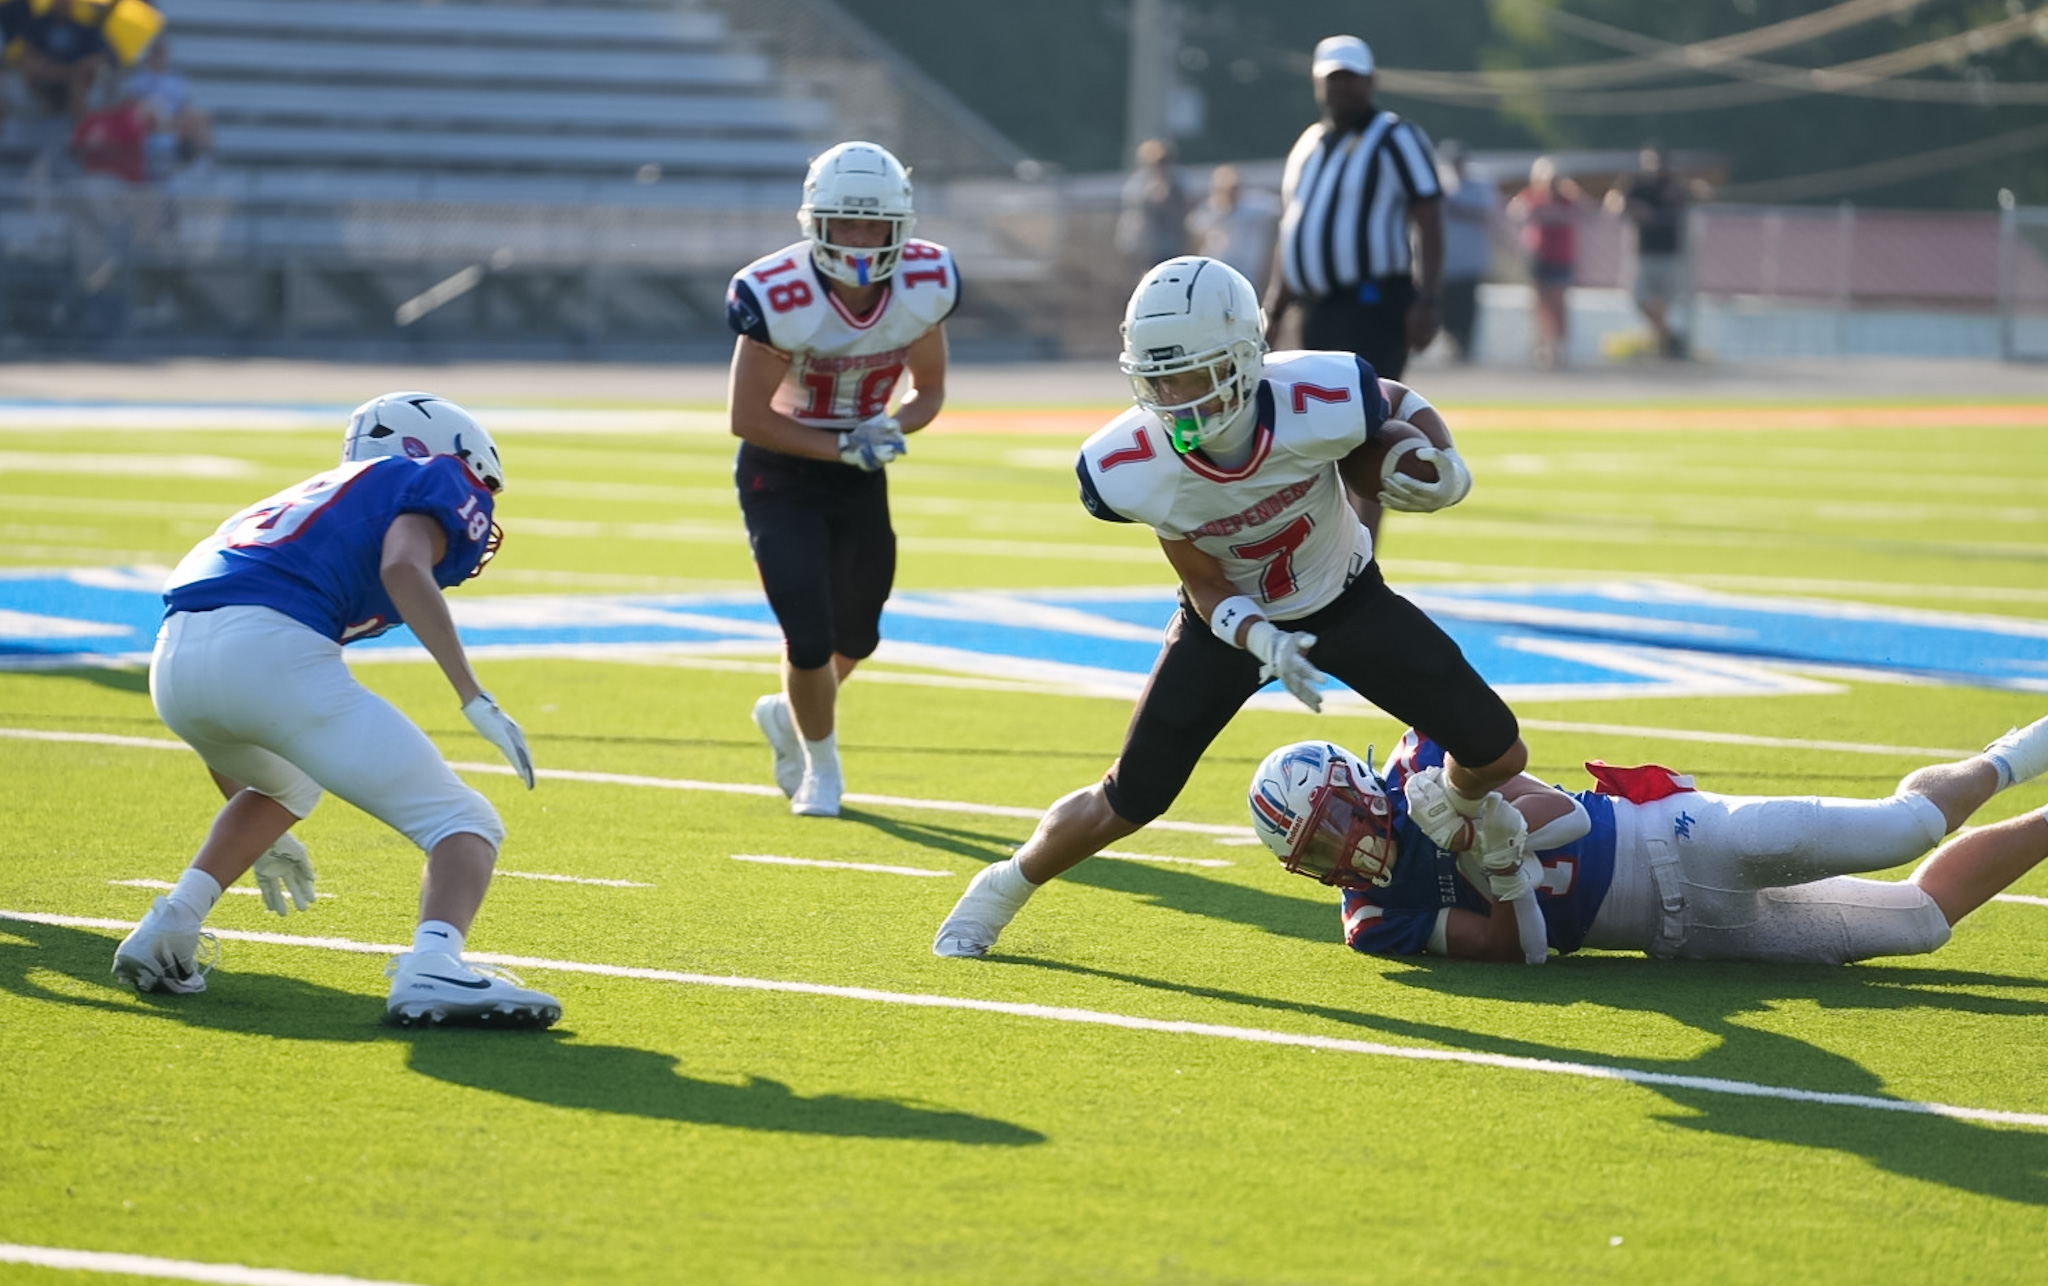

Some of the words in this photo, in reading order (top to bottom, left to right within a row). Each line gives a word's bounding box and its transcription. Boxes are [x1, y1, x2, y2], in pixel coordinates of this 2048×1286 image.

[754, 257, 815, 313] 18
[901, 242, 949, 290] 18
[1290, 381, 1351, 414] 7
[1098, 426, 1157, 472] 7
[456, 494, 490, 542] 18
[1230, 513, 1315, 603] 7
[1286, 815, 1304, 846] Riddell
